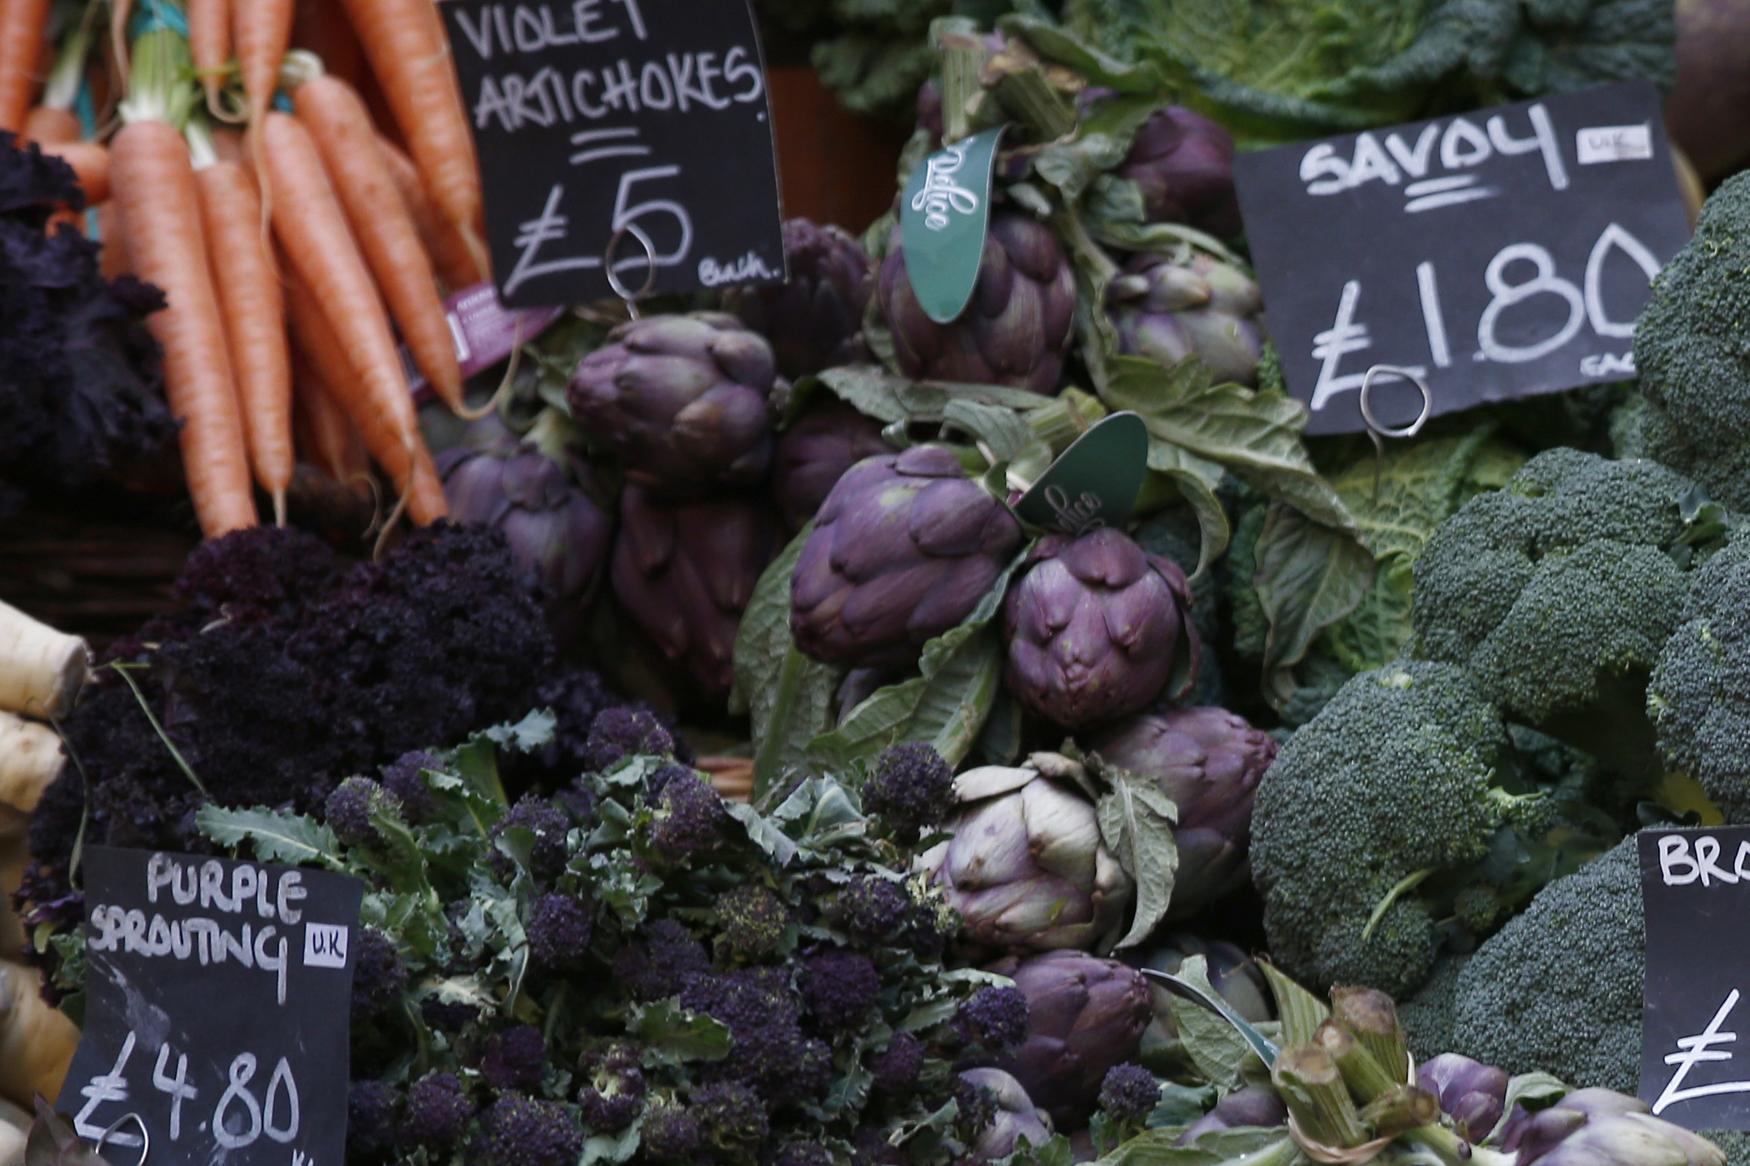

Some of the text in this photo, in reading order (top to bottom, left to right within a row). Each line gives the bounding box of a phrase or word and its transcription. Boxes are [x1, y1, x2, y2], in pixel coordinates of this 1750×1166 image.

[453, 0, 648, 59] VIOLET
[1300, 103, 1570, 195] SAVOY
[1579, 350, 1636, 377] EAC
[147, 852, 308, 925] PURPLE
[88, 904, 289, 1006] SPROUTING
[312, 930, 345, 959] U.K
[73, 1030, 299, 1149] £4.80
